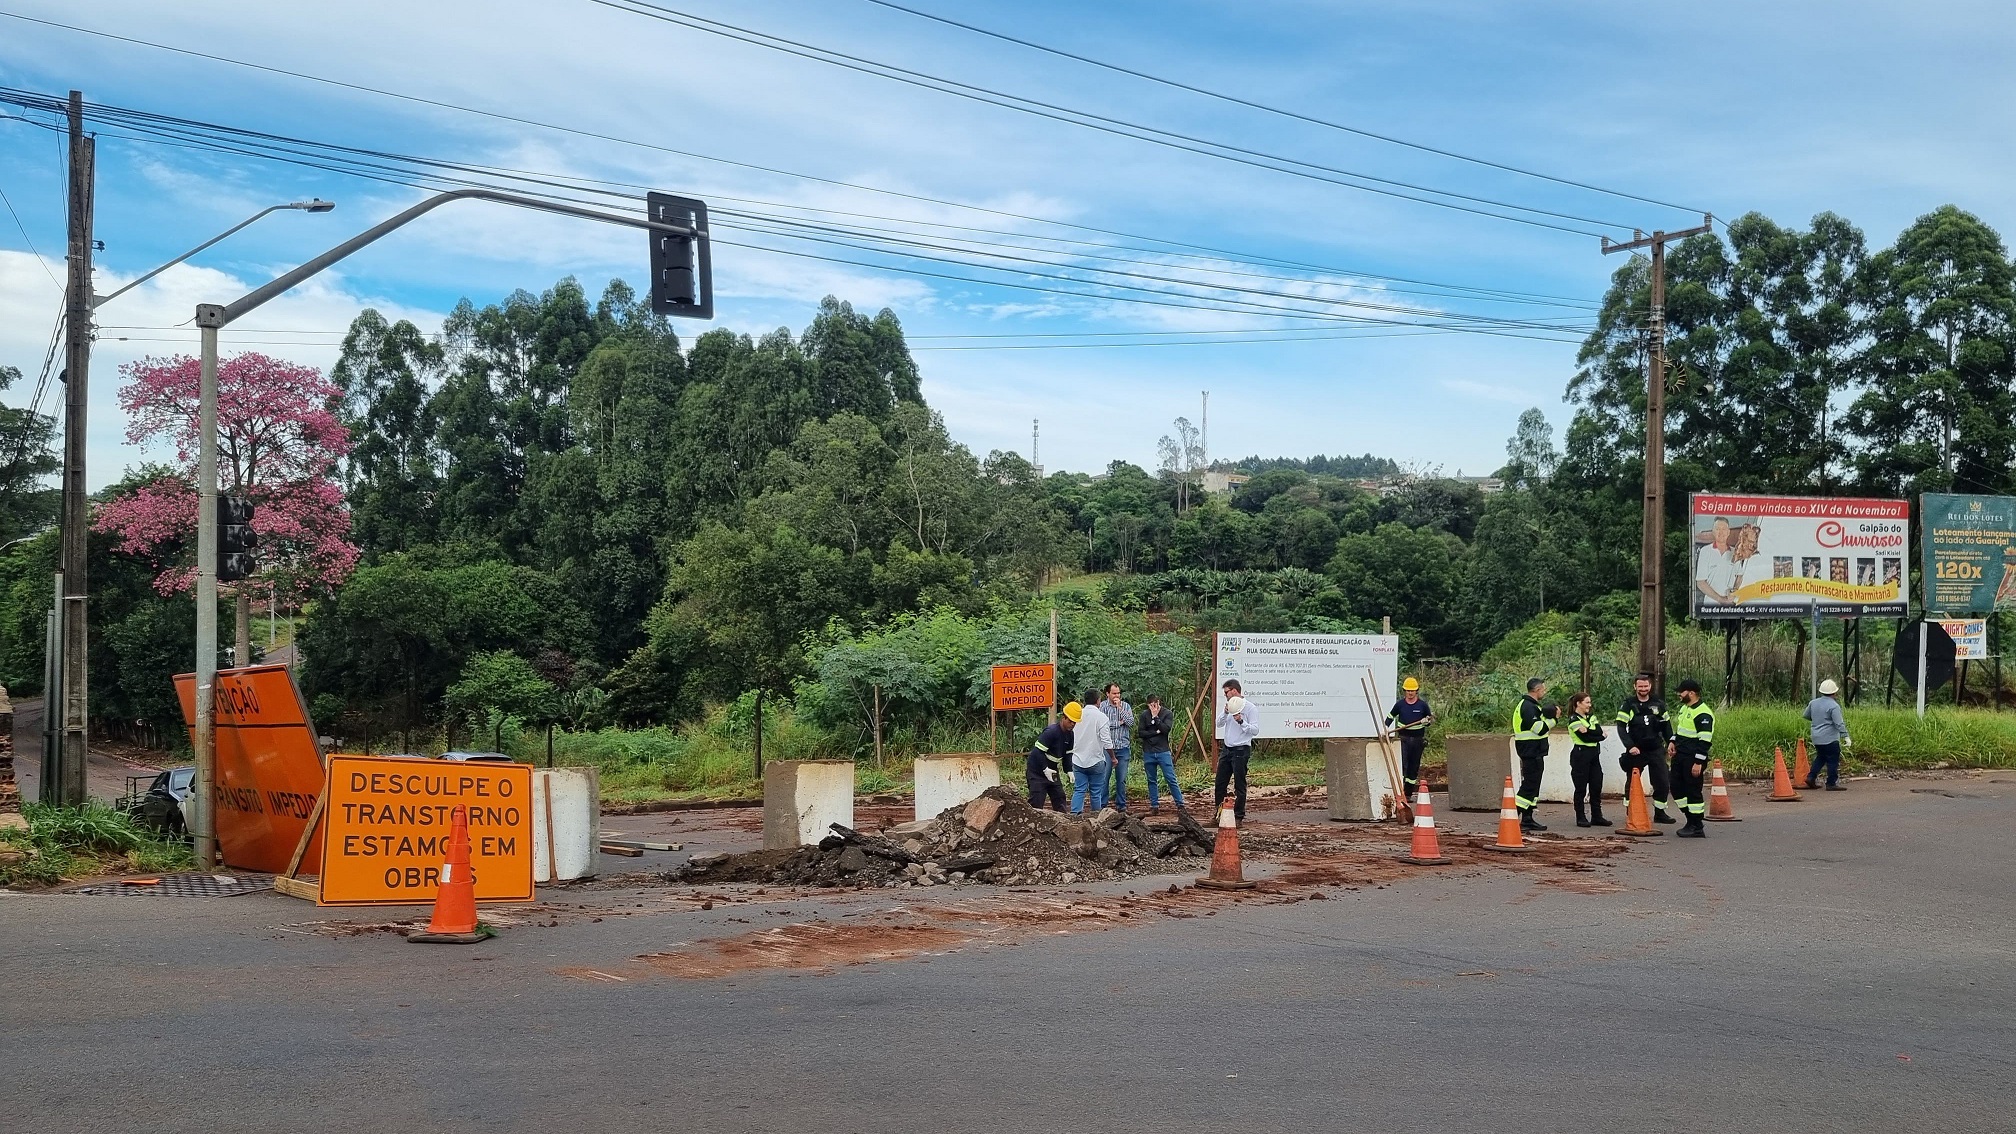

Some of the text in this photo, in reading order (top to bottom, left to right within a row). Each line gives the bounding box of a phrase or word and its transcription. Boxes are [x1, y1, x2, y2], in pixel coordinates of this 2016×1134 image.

[1701, 500, 1733, 513] Sejam
[1735, 502, 1757, 512] bem
[1760, 503, 1792, 513] vindos
[1809, 504, 1828, 514] XIV
[1830, 505, 1842, 514] de
[1845, 505, 1901, 516] Novembro!
[1816, 520, 1902, 548] Churrasco
[1860, 524, 1902, 534] Galpão do
[1933, 528, 1982, 537] Loteamento
[1936, 561, 1982, 579] 120x
[1760, 581, 1891, 600] Restaurante, Churrascaria e Marmitaria
[1946, 622, 1983, 635] NIGHT DRINKS
[1316, 638, 1362, 646] REQUALIFICAÇÃO
[1002, 668, 1044, 679] ATENÇÃO
[1002, 684, 1046, 694] TRÂNSITO
[216, 680, 260, 722] TENÇÃO
[1002, 695, 1045, 705] IMPEDIDO
[350, 772, 514, 798] DESCULPE O
[216, 780, 264, 814] RÂNSITO
[481, 837, 516, 856] EM
